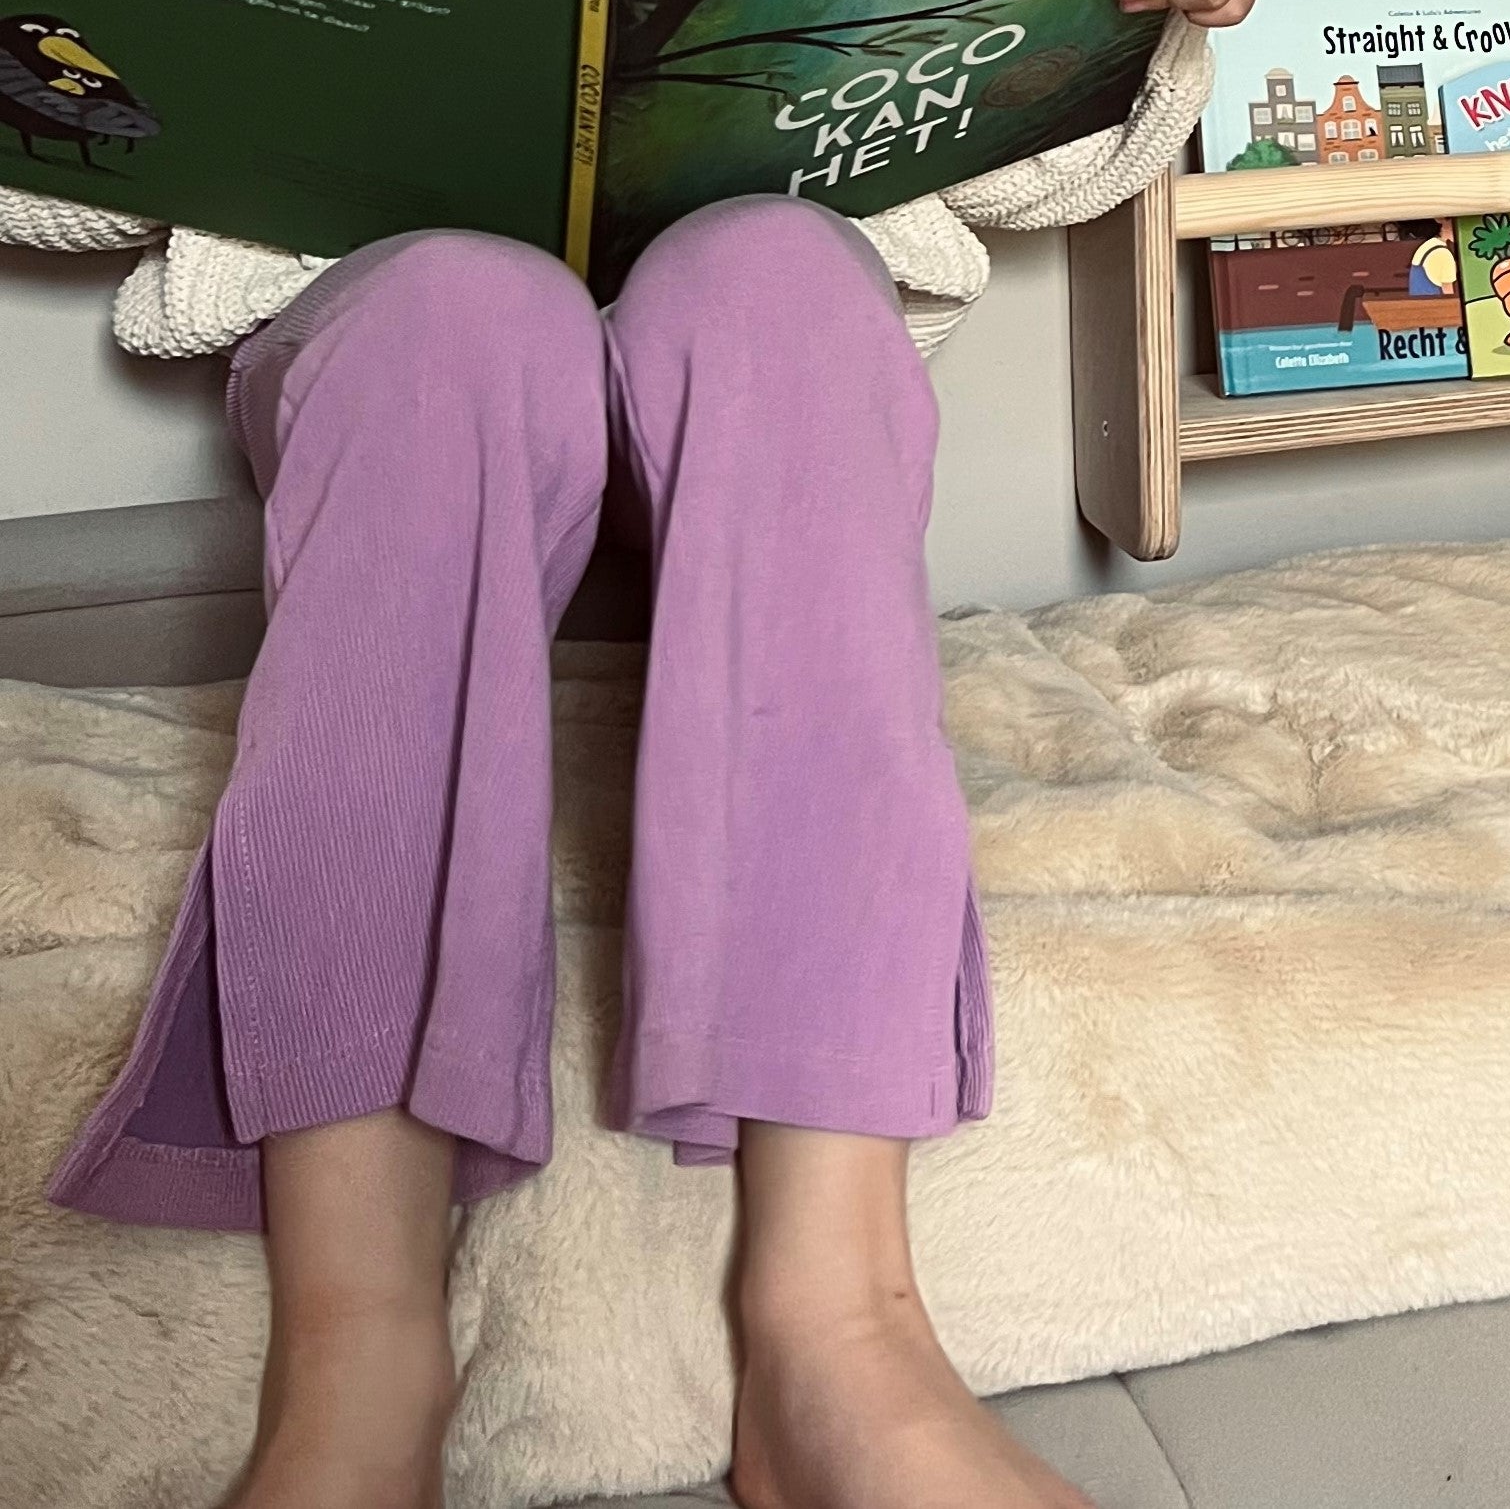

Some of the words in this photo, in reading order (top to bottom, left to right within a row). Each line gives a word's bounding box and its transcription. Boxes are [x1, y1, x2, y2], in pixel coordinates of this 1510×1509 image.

[774, 24, 1026, 130] COCO
[1323, 25, 1426, 59] Straight
[1432, 25, 1449, 50] &
[788, 107, 973, 198] HET!
[813, 74, 969, 158] KAN
[1378, 327, 1447, 361] Recht
